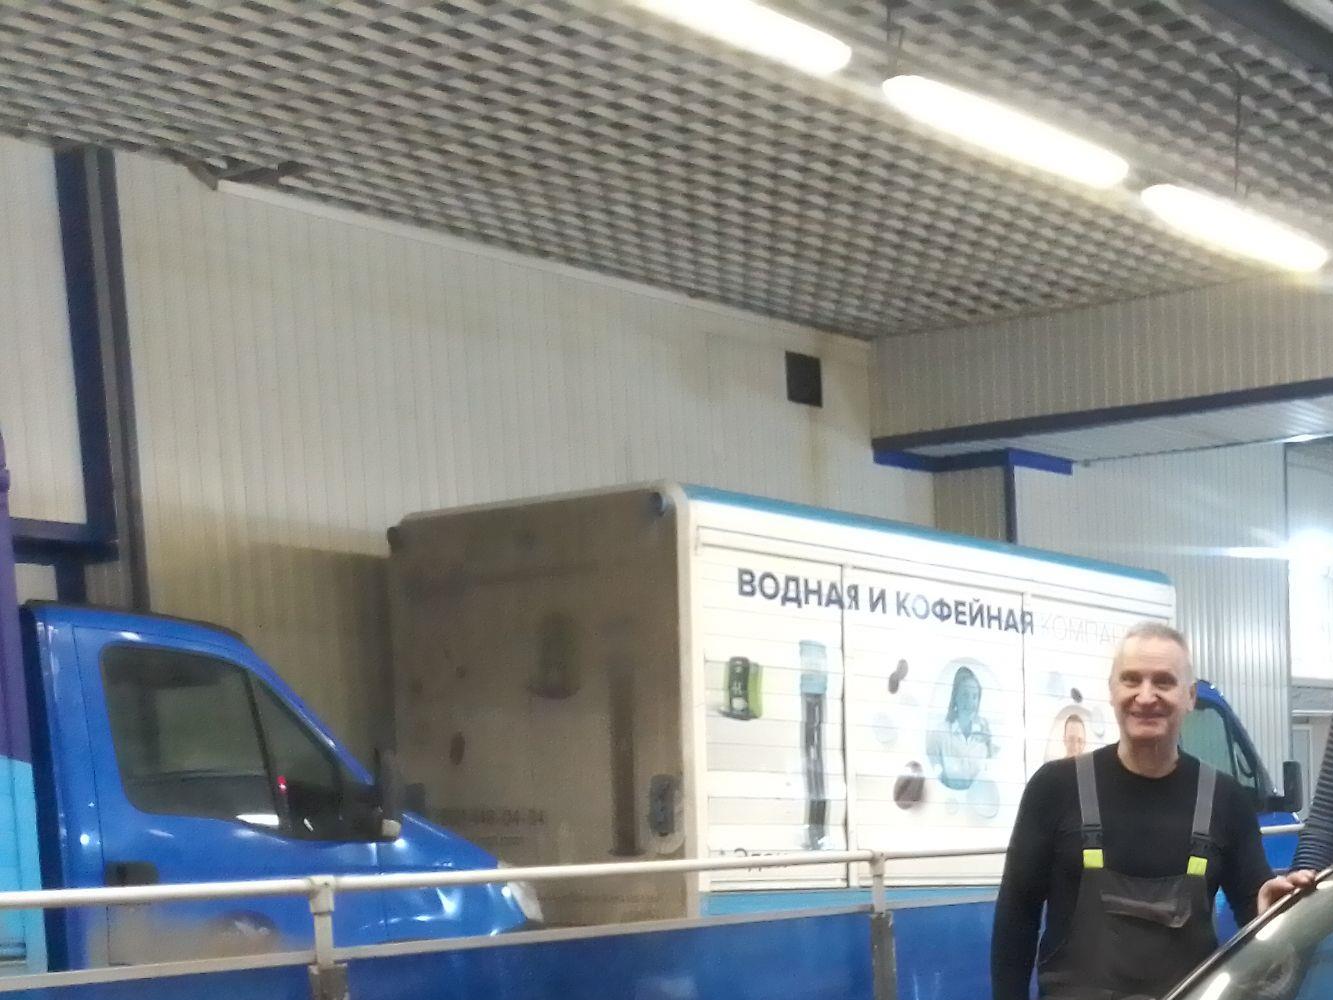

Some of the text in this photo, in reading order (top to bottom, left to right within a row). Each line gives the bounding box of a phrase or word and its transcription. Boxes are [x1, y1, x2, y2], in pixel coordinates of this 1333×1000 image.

[737, 567, 860, 610] ВОДНАЯ
[869, 586, 887, 614] И
[896, 590, 1034, 636] КОФЕЙНАЯ
